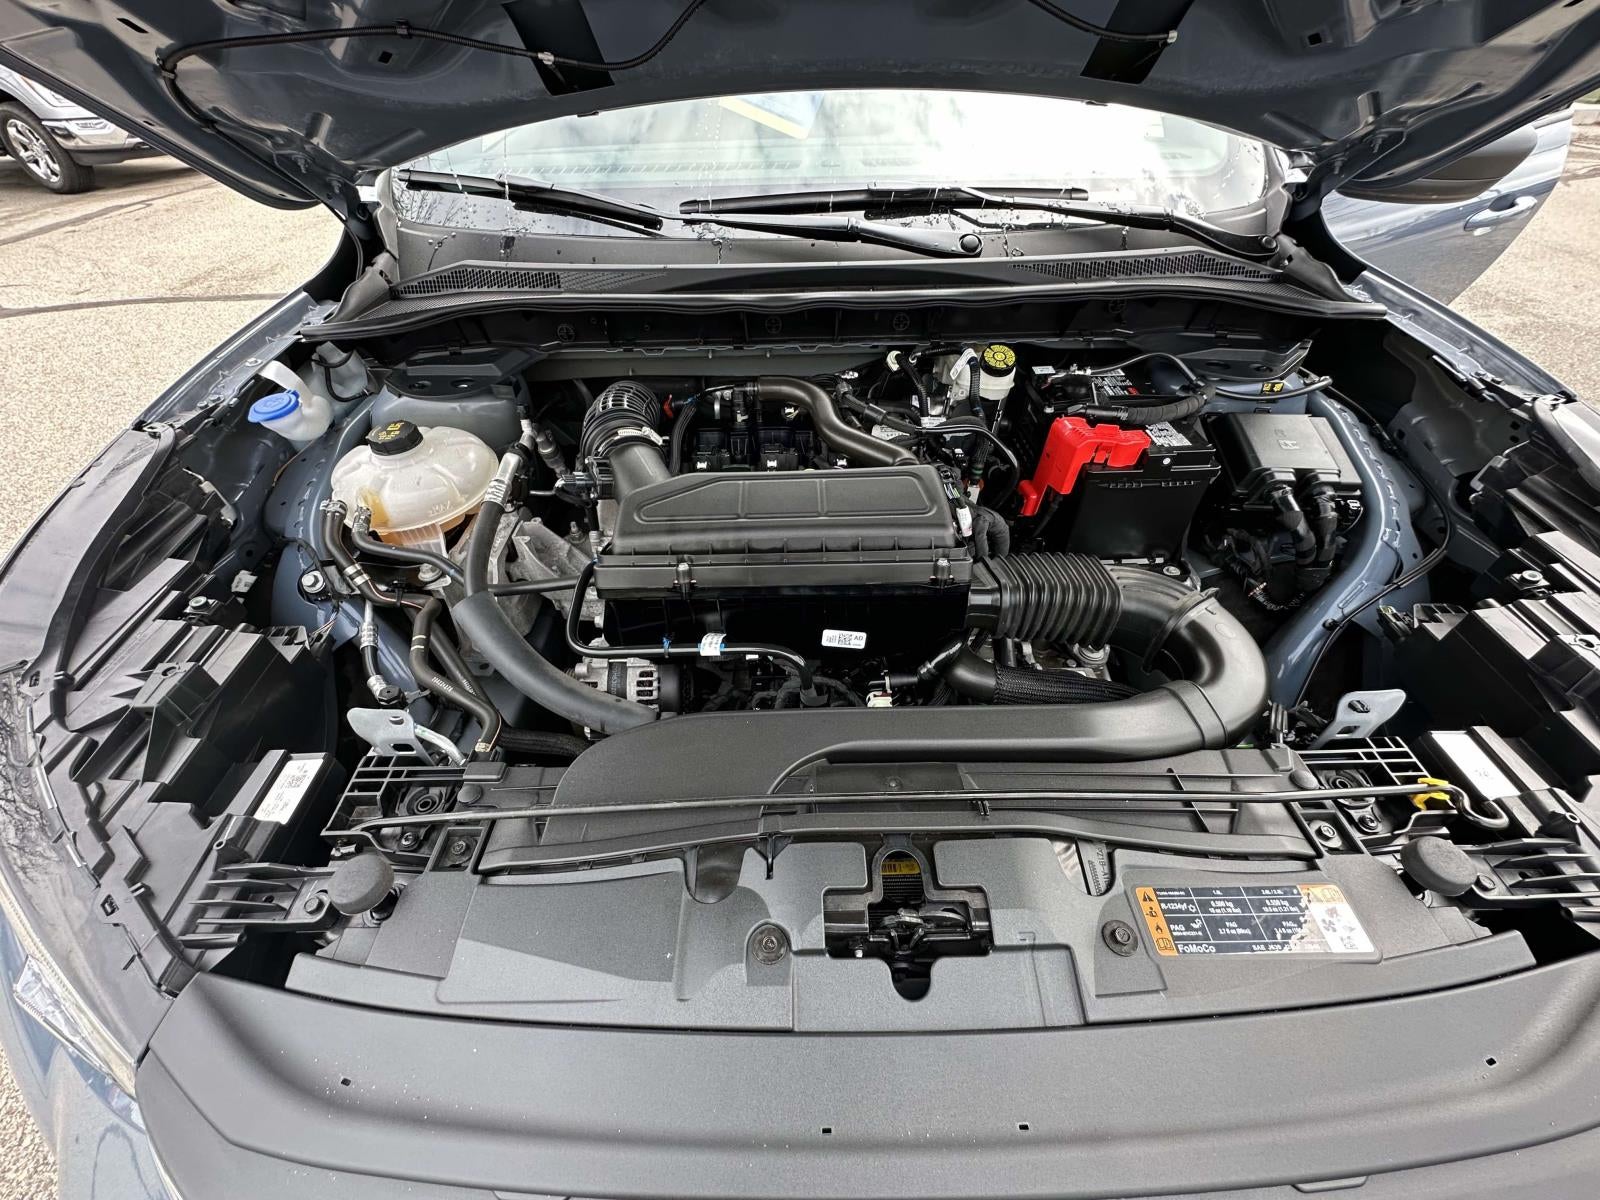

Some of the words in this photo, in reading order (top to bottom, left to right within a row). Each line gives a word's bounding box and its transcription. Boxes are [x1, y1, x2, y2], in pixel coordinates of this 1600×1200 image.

[1160, 902, 1188, 911] R-1234yf
[1169, 924, 1186, 932] PAG
[1177, 944, 1217, 953] FoMoCo
